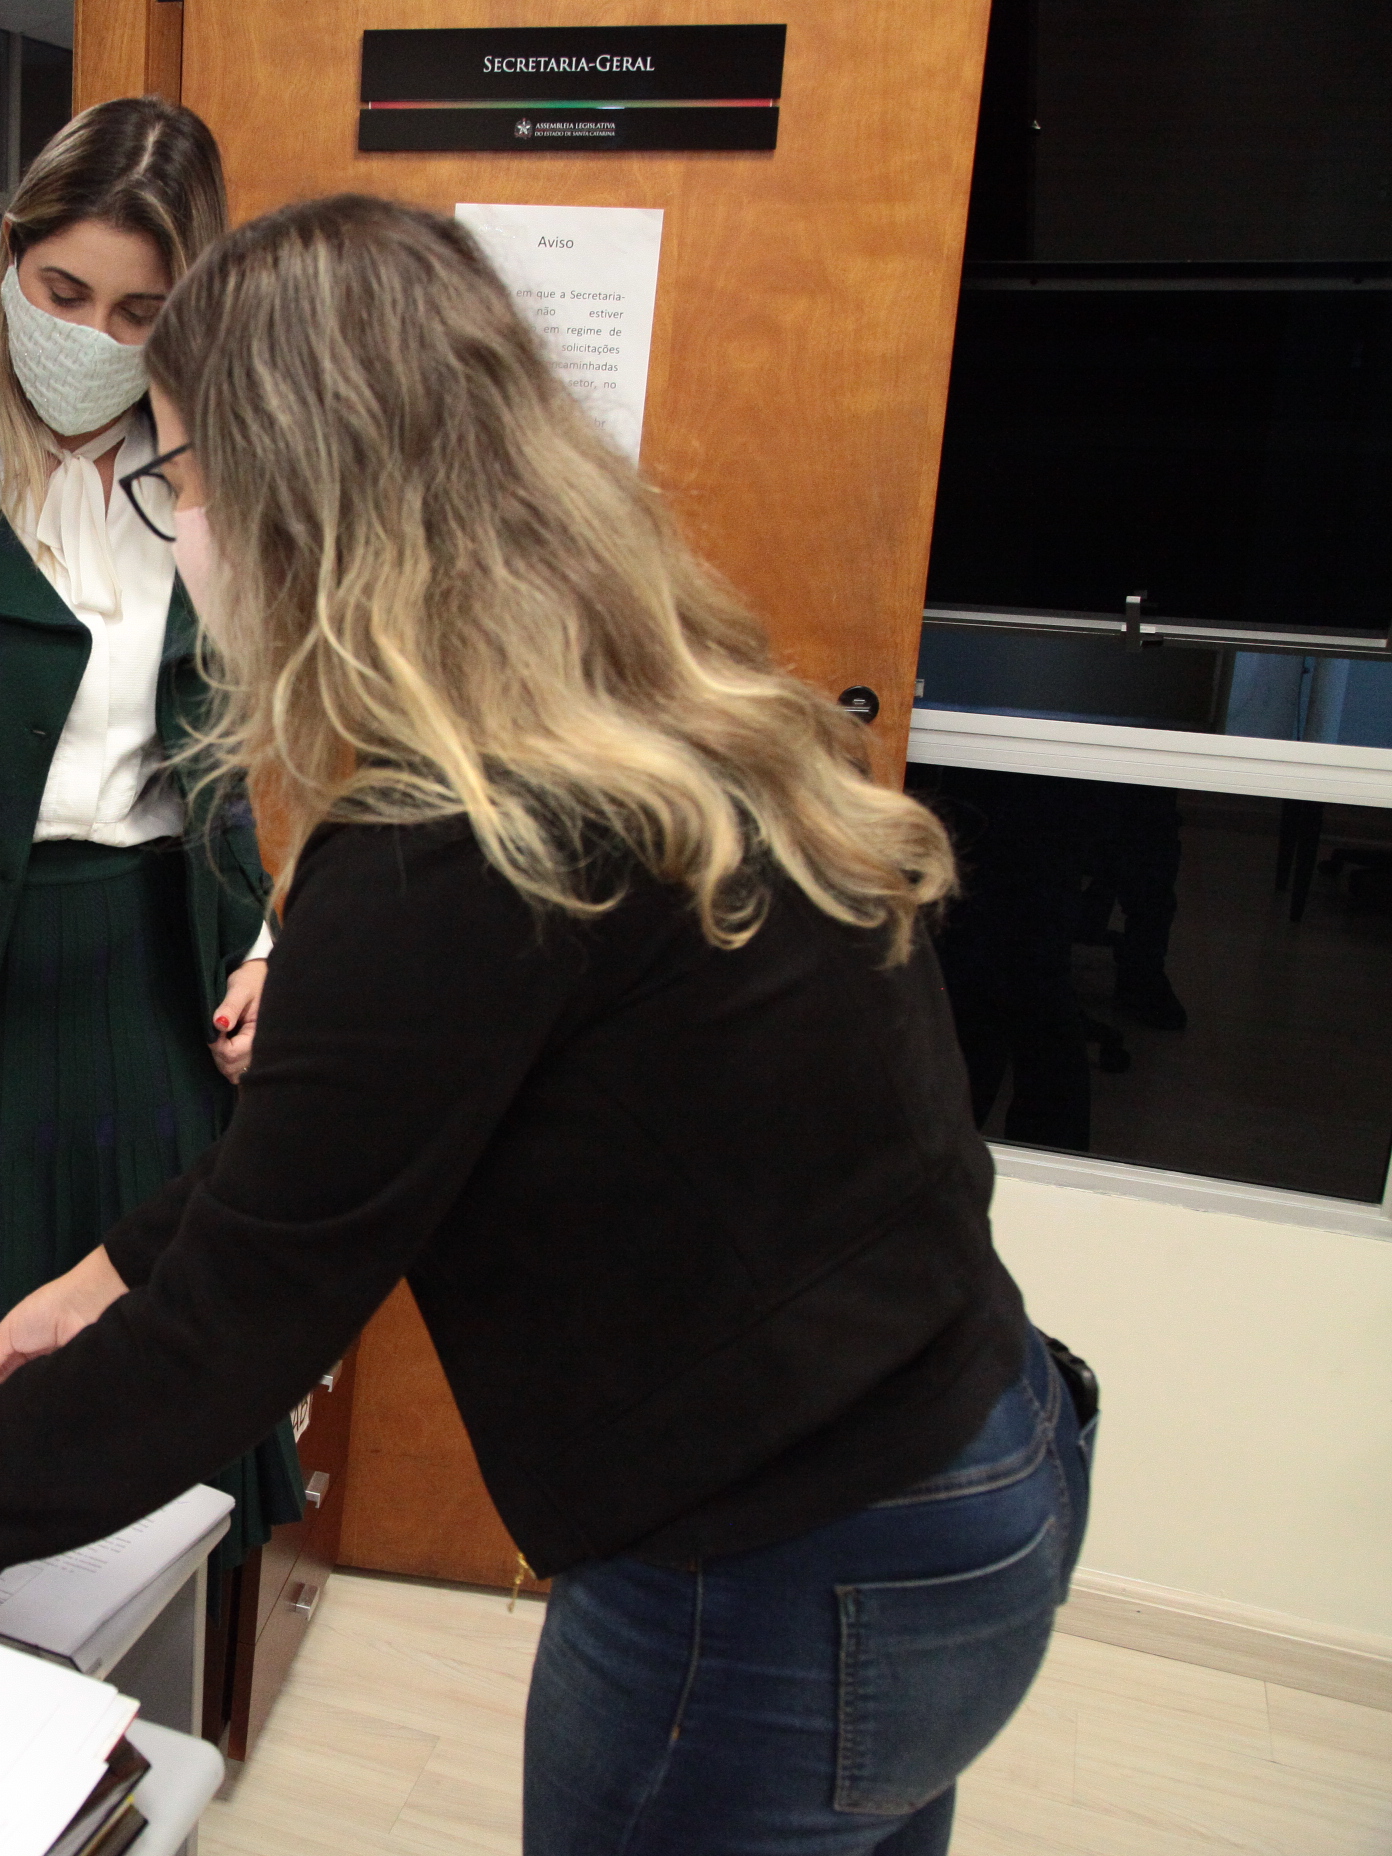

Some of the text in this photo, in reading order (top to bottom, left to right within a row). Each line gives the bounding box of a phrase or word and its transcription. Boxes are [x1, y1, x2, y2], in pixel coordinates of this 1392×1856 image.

[535, 122, 616, 130] ASSEMBLEIA LEGISLATIVA
[537, 236, 574, 249] Aviso
[516, 289, 626, 301] em que a Secretaria-
[536, 307, 624, 319] não estiver
[544, 326, 622, 337] em regime de
[562, 343, 620, 355] solicitações
[568, 379, 617, 389] setor, no
